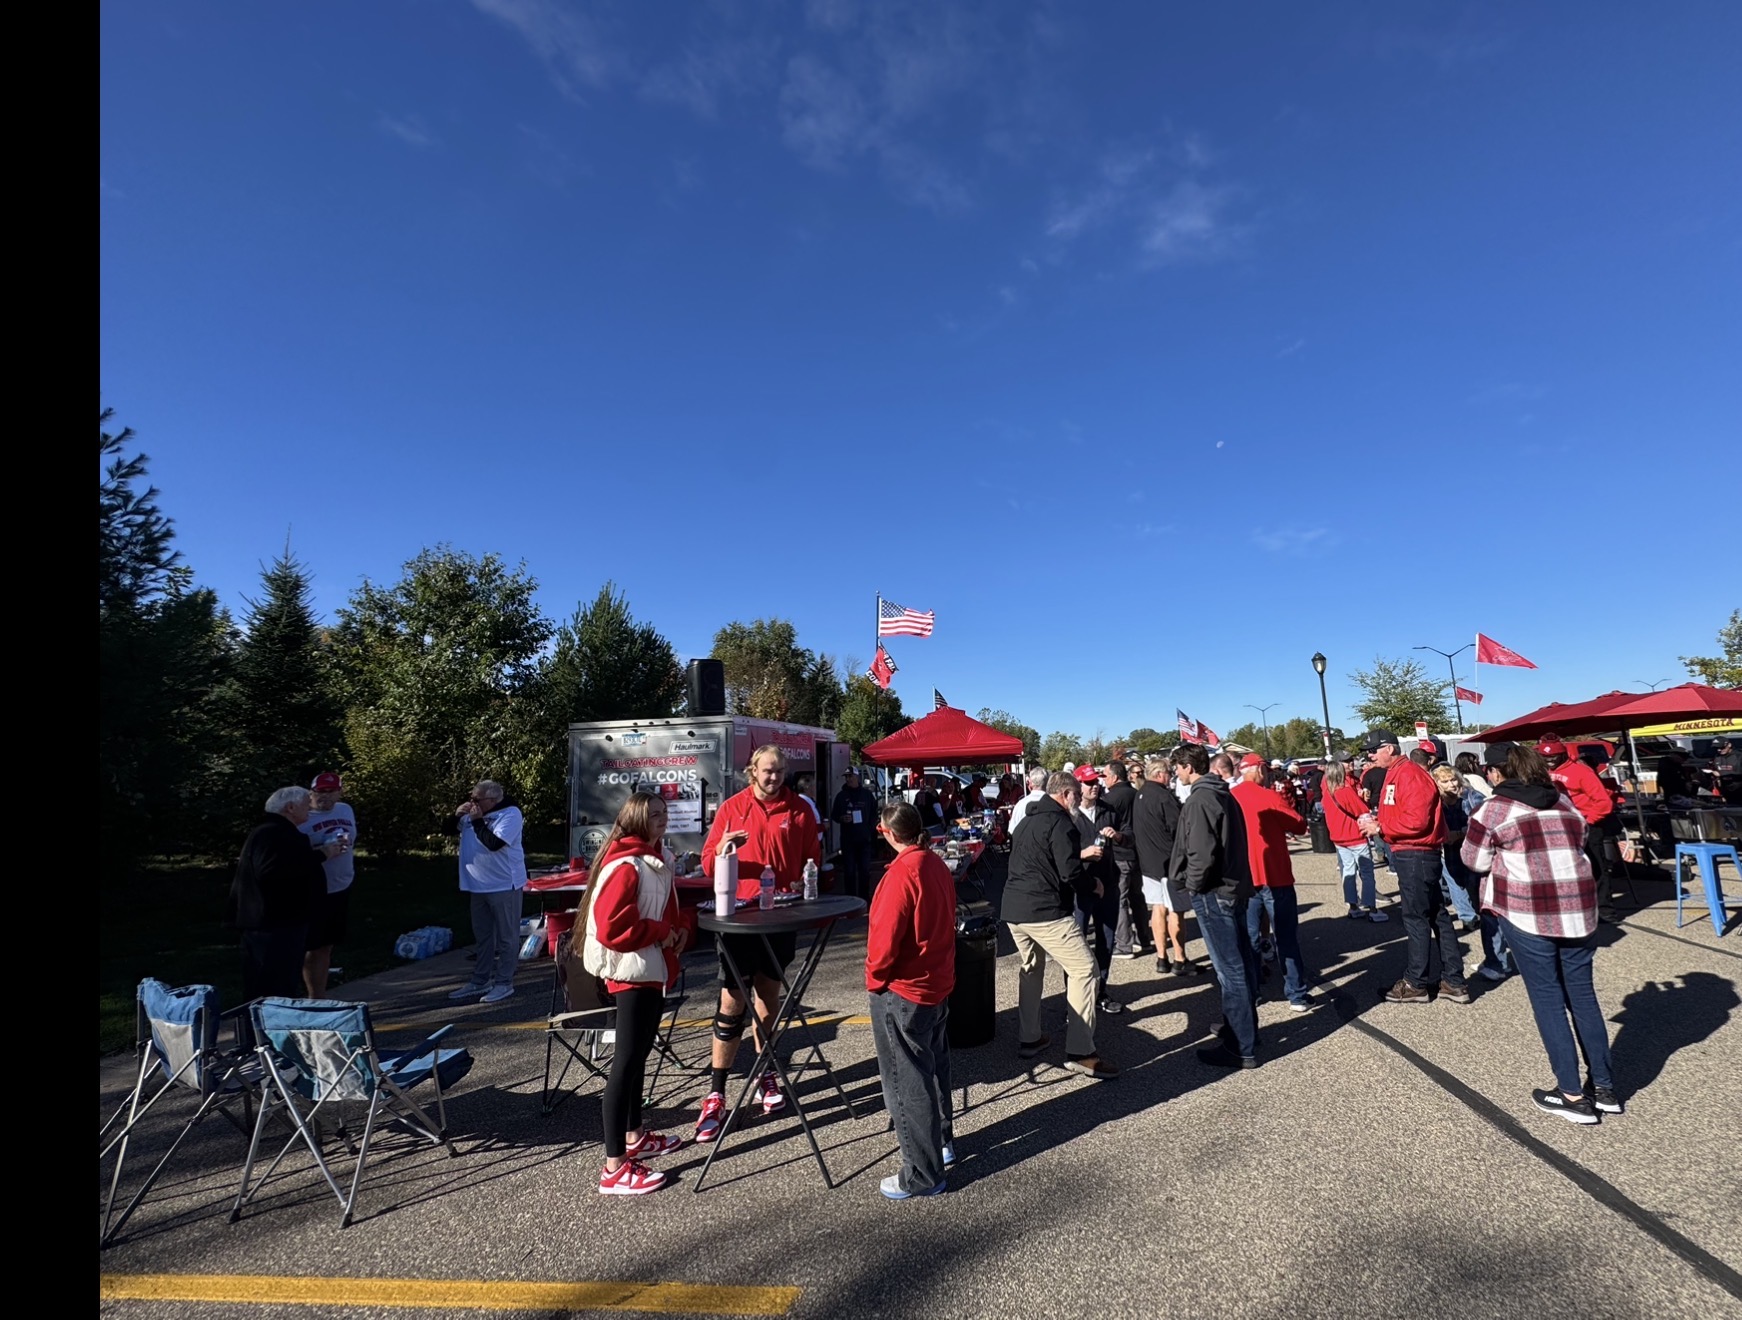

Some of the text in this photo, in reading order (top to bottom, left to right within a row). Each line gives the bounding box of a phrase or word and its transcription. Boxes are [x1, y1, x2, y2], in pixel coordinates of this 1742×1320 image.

[1674, 718, 1734, 730] MINNESOTA
[674, 742, 711, 751] Haulmark
[598, 769, 698, 785] #GOFALCONS
